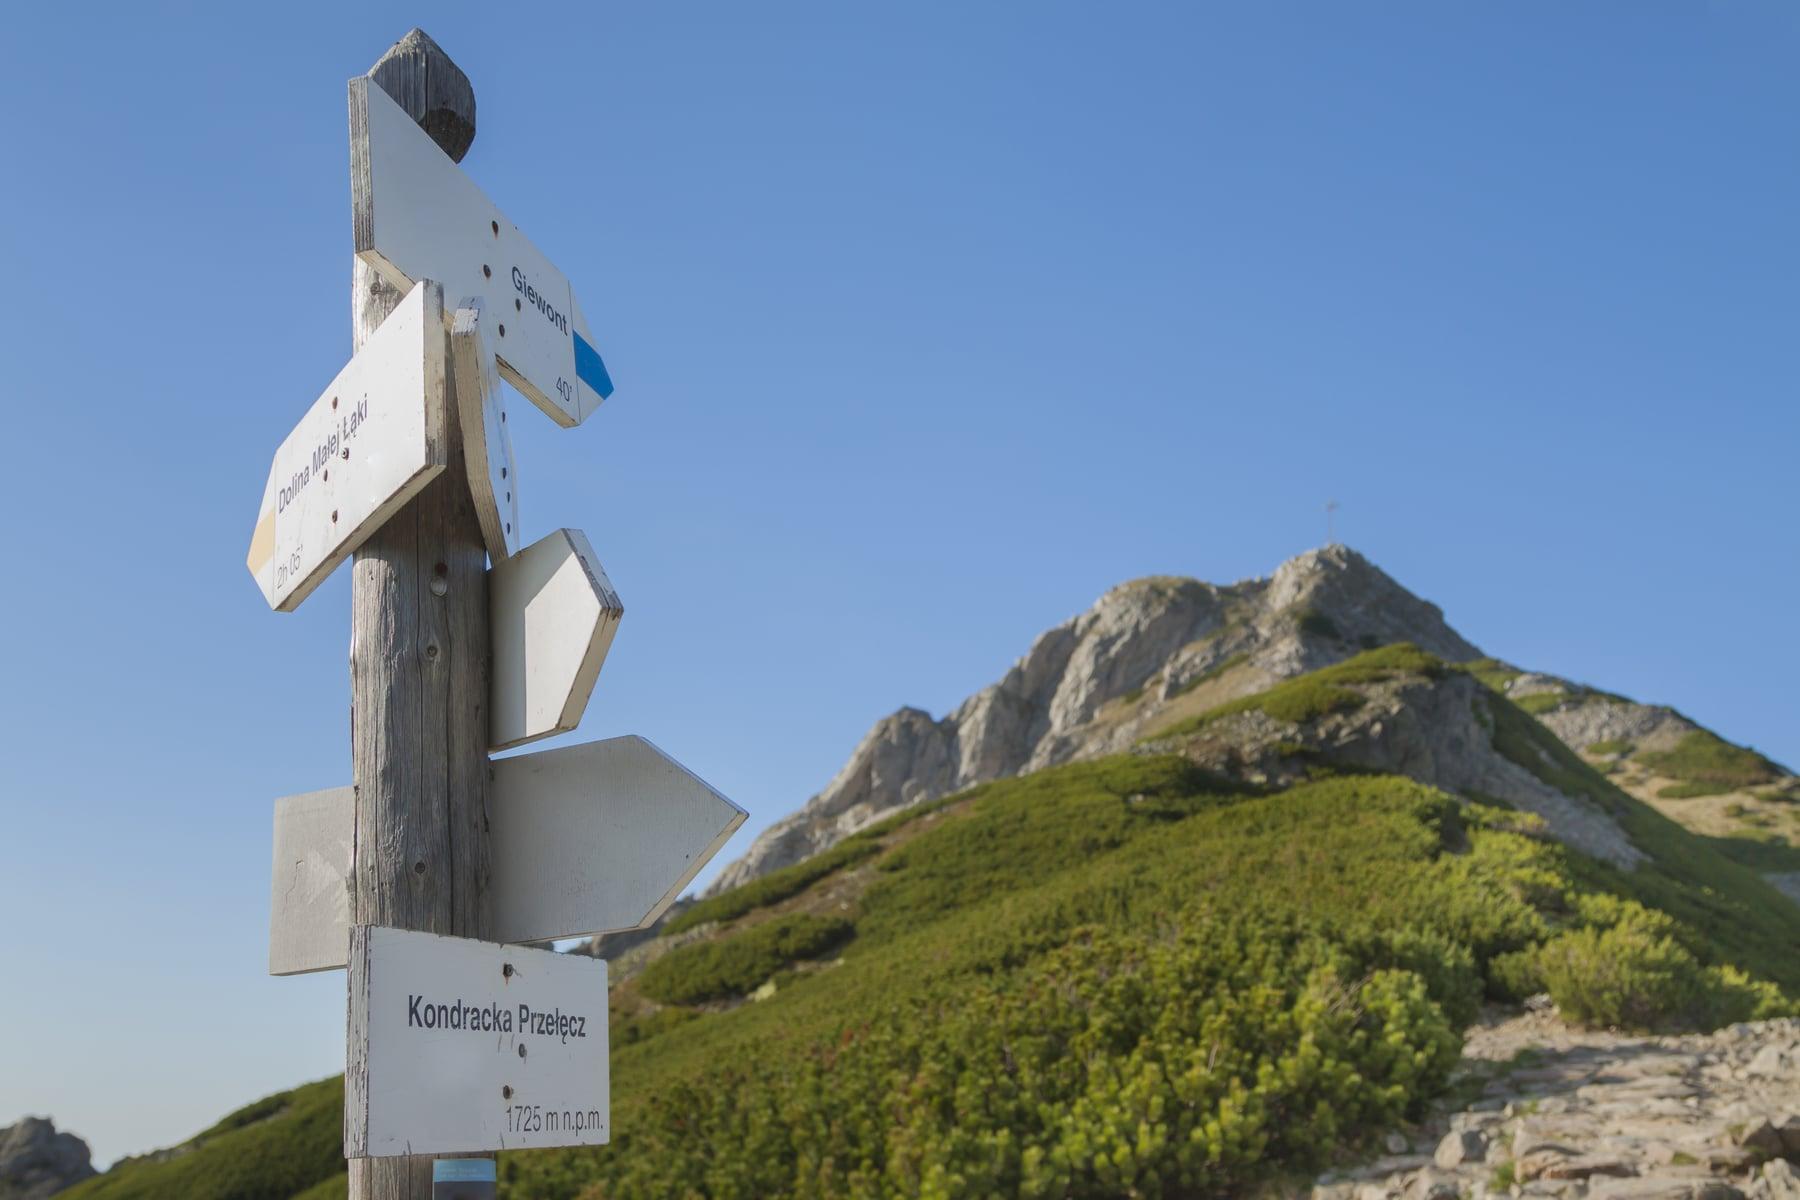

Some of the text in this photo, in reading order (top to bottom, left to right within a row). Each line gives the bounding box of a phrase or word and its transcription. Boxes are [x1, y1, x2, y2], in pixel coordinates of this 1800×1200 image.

[512, 266, 568, 336] Giewont
[278, 393, 368, 514] Dolina Małej Łąki
[277, 563, 288, 589] 2h
[408, 995, 586, 1045] Kondracka Przełęcz
[506, 1105, 604, 1137] 1725 m n.p.m.
